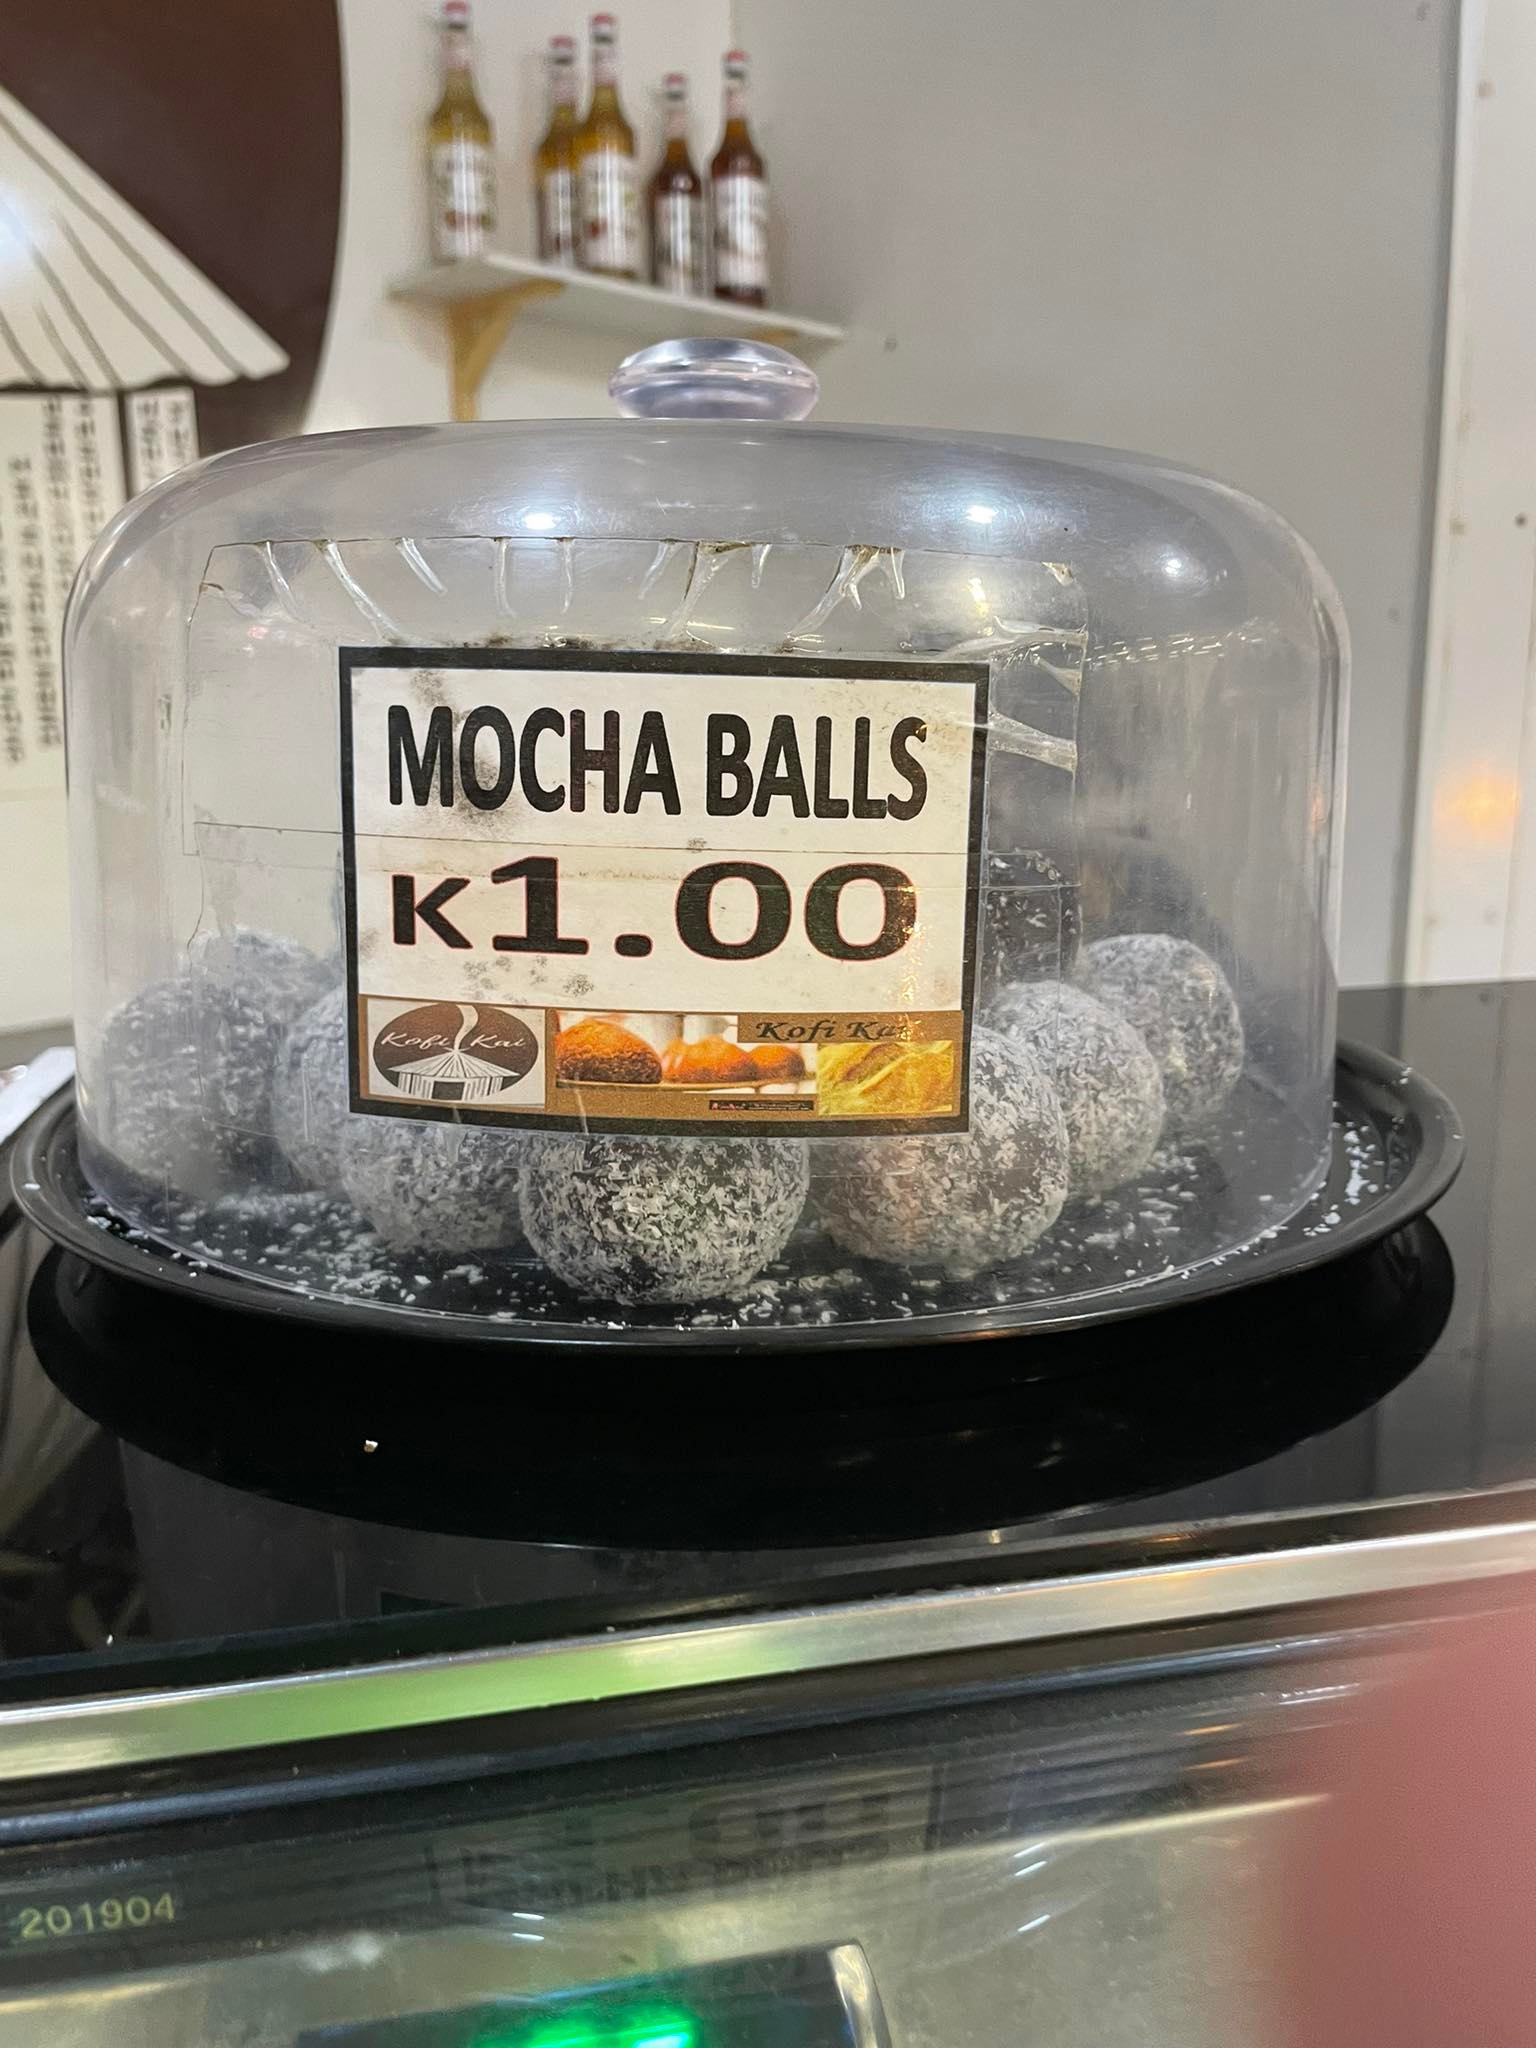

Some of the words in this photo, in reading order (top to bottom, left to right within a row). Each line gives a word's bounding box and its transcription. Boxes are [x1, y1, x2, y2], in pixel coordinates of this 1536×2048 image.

[387, 704, 682, 816] MOCHA
[705, 712, 928, 822] BALLS
[391, 855, 918, 962] K1.00
[380, 1031, 452, 1050] Kofi
[469, 1033, 526, 1049] Kai
[755, 1019, 837, 1043] Kofi
[18, 1892, 175, 1941] 201904
